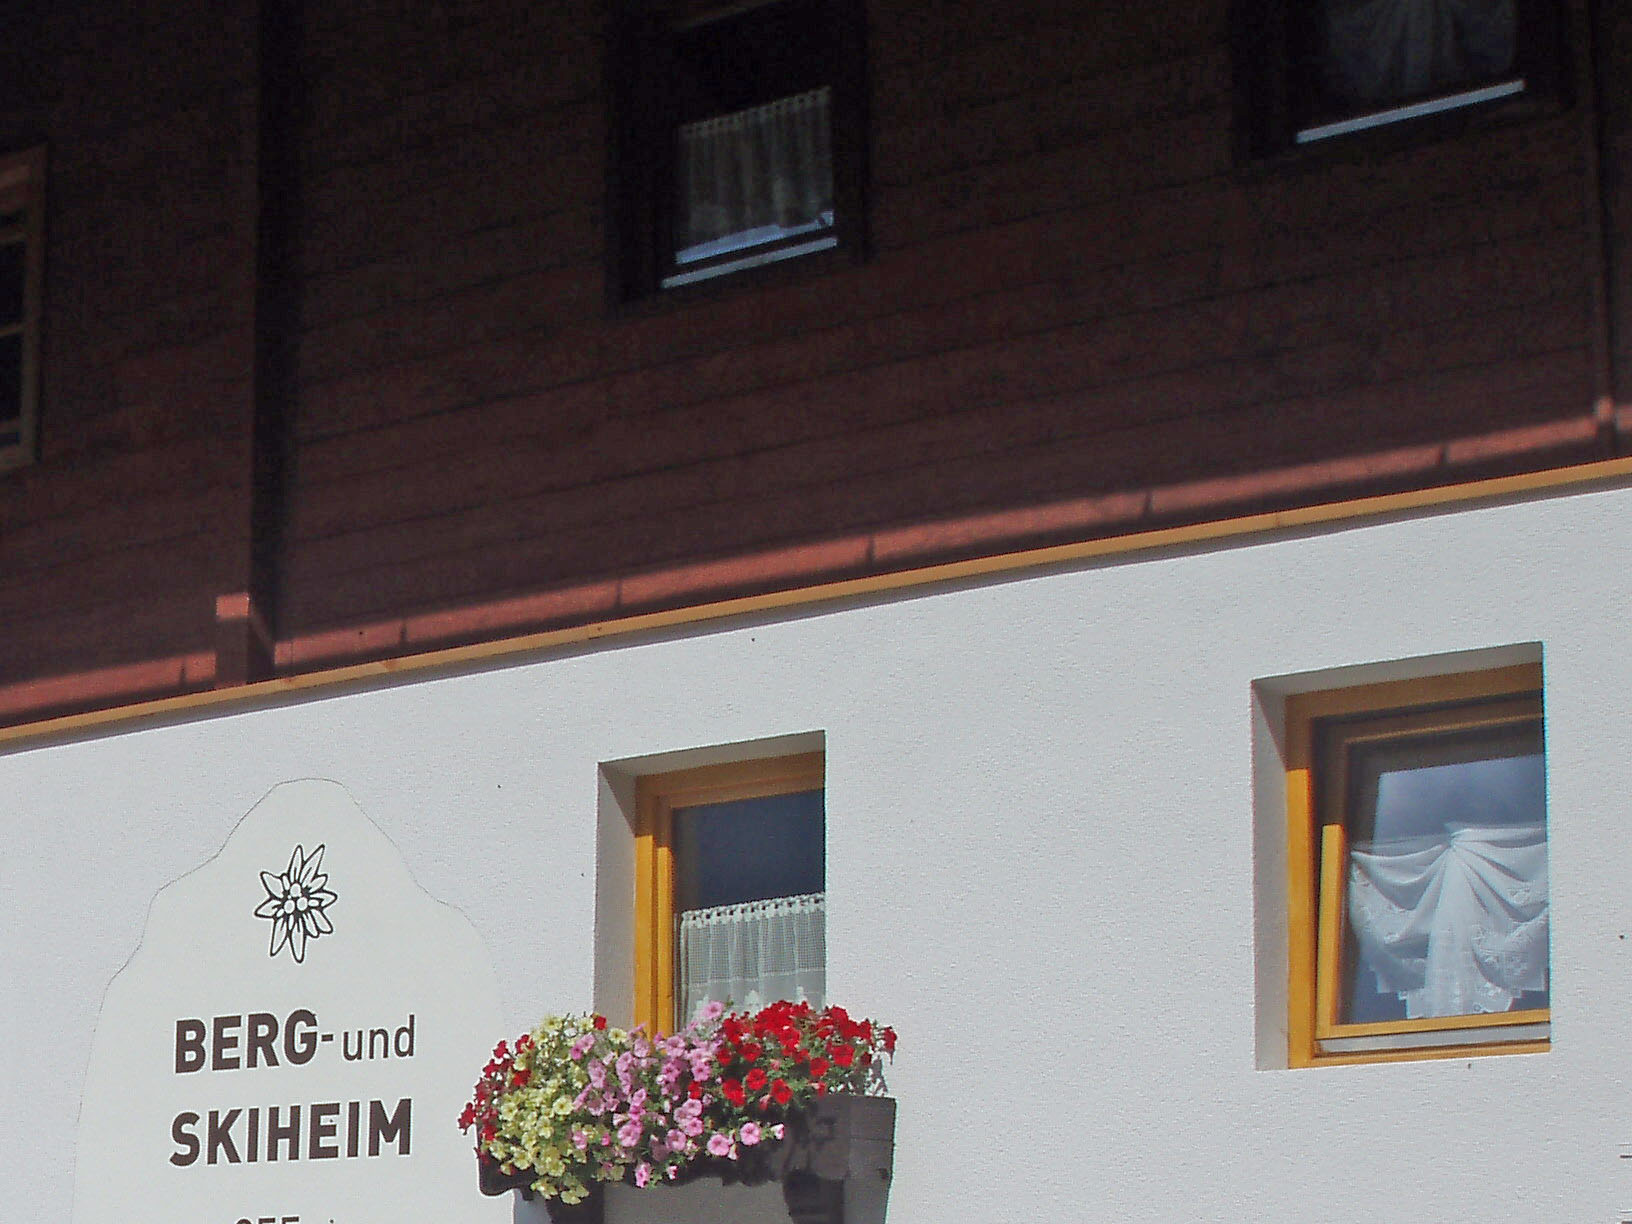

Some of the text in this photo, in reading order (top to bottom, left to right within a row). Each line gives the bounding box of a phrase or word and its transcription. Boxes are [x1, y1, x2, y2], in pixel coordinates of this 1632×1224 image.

[174, 1008, 416, 1074] BERG- und
[169, 1097, 413, 1167] SKIHEIM
